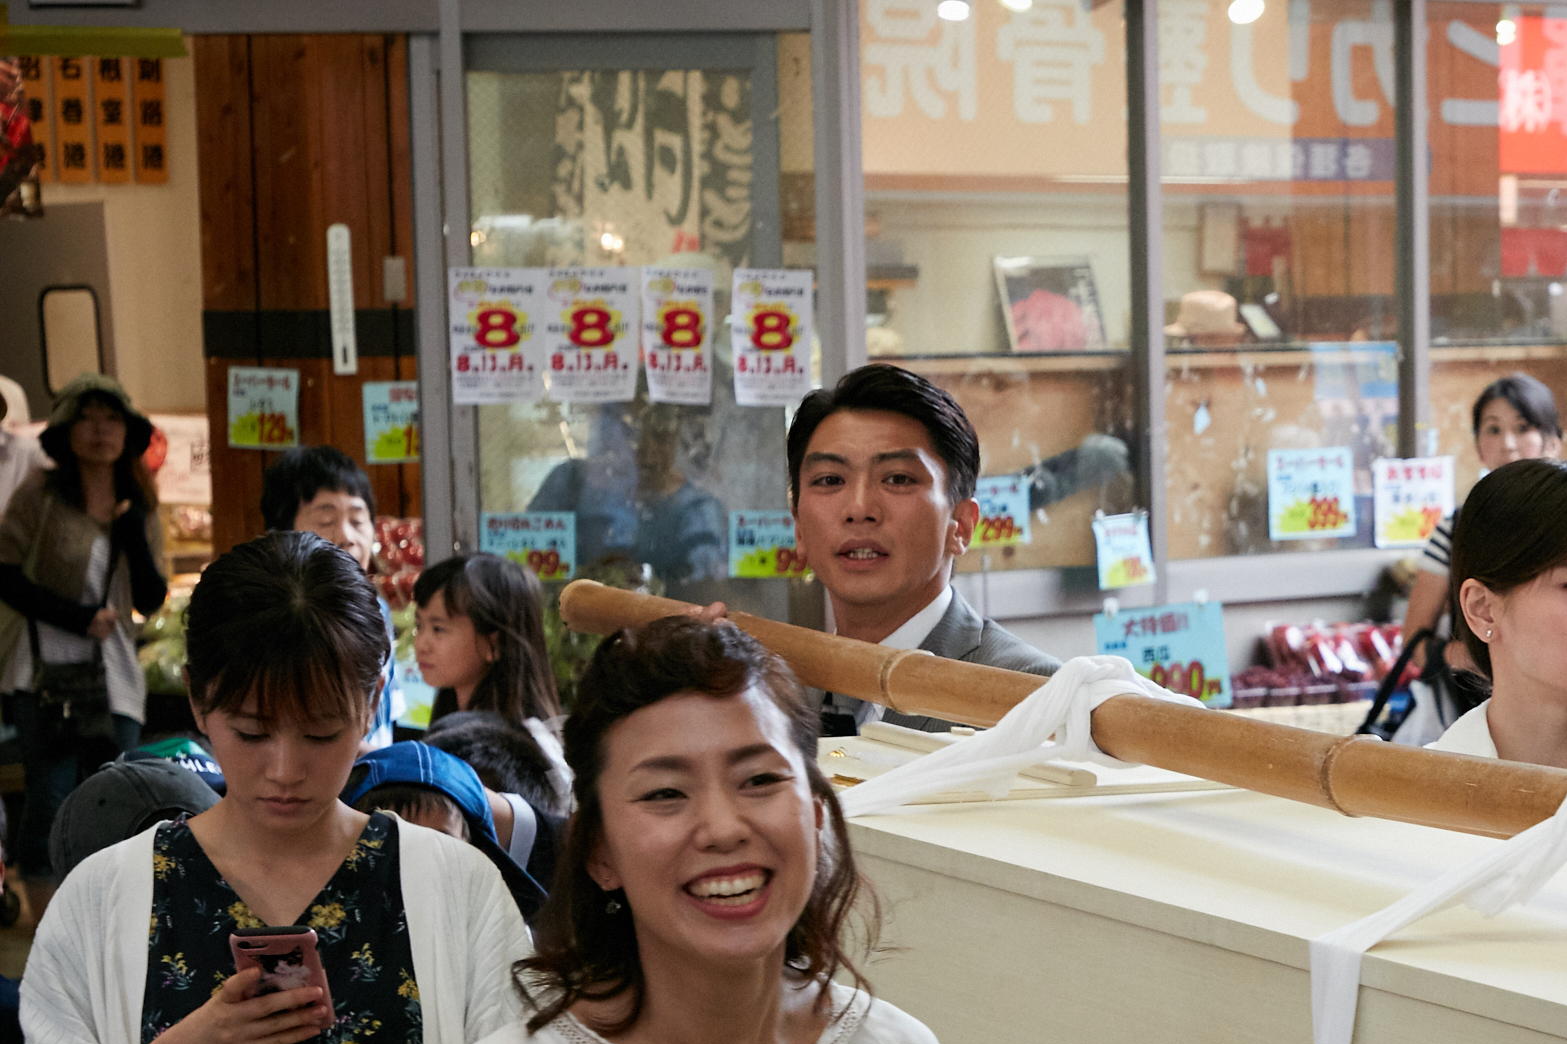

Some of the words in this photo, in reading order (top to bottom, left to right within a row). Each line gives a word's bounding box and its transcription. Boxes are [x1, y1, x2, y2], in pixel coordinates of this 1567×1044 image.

[475, 308, 520, 348] 8
[568, 307, 614, 347] 8
[663, 309, 701, 348] 8
[751, 311, 792, 350] 8
